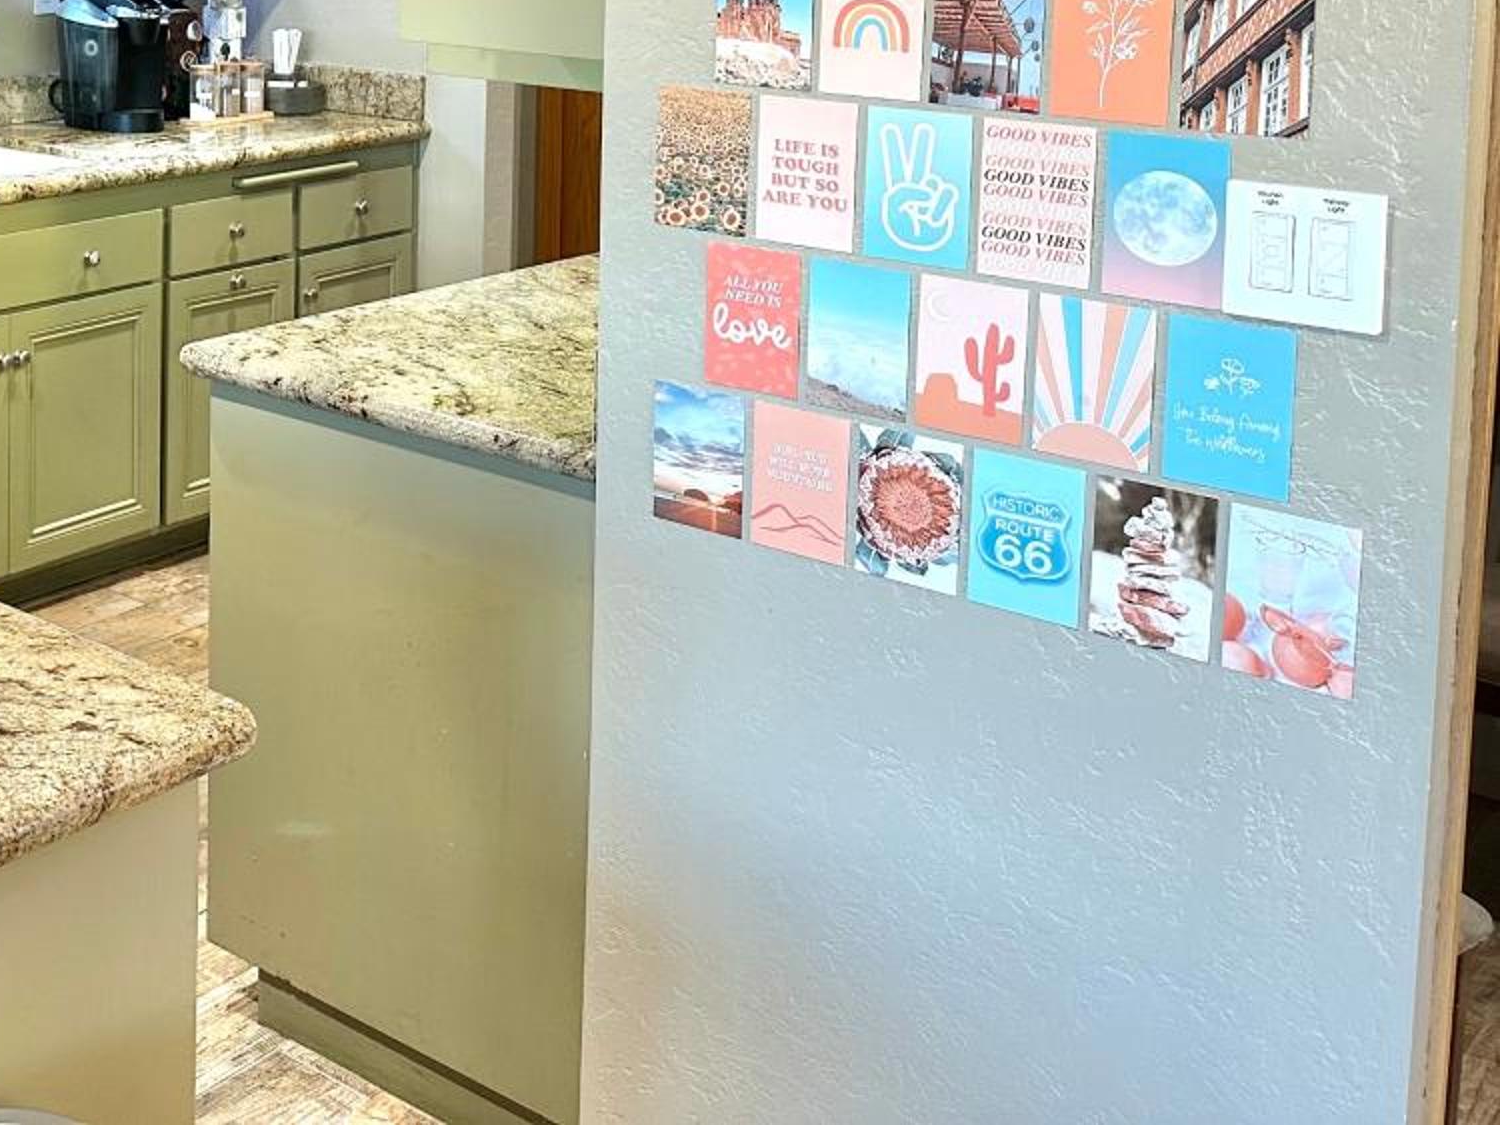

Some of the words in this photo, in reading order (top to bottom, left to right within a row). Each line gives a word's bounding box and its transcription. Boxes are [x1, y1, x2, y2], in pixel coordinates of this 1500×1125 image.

[774, 139, 816, 156] LIFE
[821, 144, 840, 158] IS
[987, 125, 1037, 143] GOOD
[1041, 132, 1093, 148] VIBES
[772, 156, 840, 176] TOUGH
[985, 154, 1035, 171] GOOD
[1040, 161, 1092, 178] VIBES
[771, 172, 808, 190] BUT
[815, 178, 840, 193] SO
[984, 169, 1034, 186] GOOD
[1038, 174, 1091, 193] VIBES
[762, 189, 801, 206] ARE
[807, 195, 848, 213] YOU
[983, 184, 1033, 200] GOOD
[1038, 190, 1088, 208] VIBES
[982, 213, 1032, 229] GOOD
[1037, 218, 1088, 236] VIBES
[981, 226, 1031, 243] GOOD
[1035, 232, 1087, 252] VIBES
[981, 240, 1031, 257] GOOD
[1034, 246, 1086, 266] VIBES
[723, 276, 750, 291] ALL
[753, 281, 784, 295] YOU
[724, 288, 765, 305] NEED
[767, 295, 782, 308] IS
[713, 302, 792, 349] love
[993, 494, 1061, 520] HISTORIC
[995, 518, 1056, 541] ROUTE
[994, 534, 1052, 575] 66
